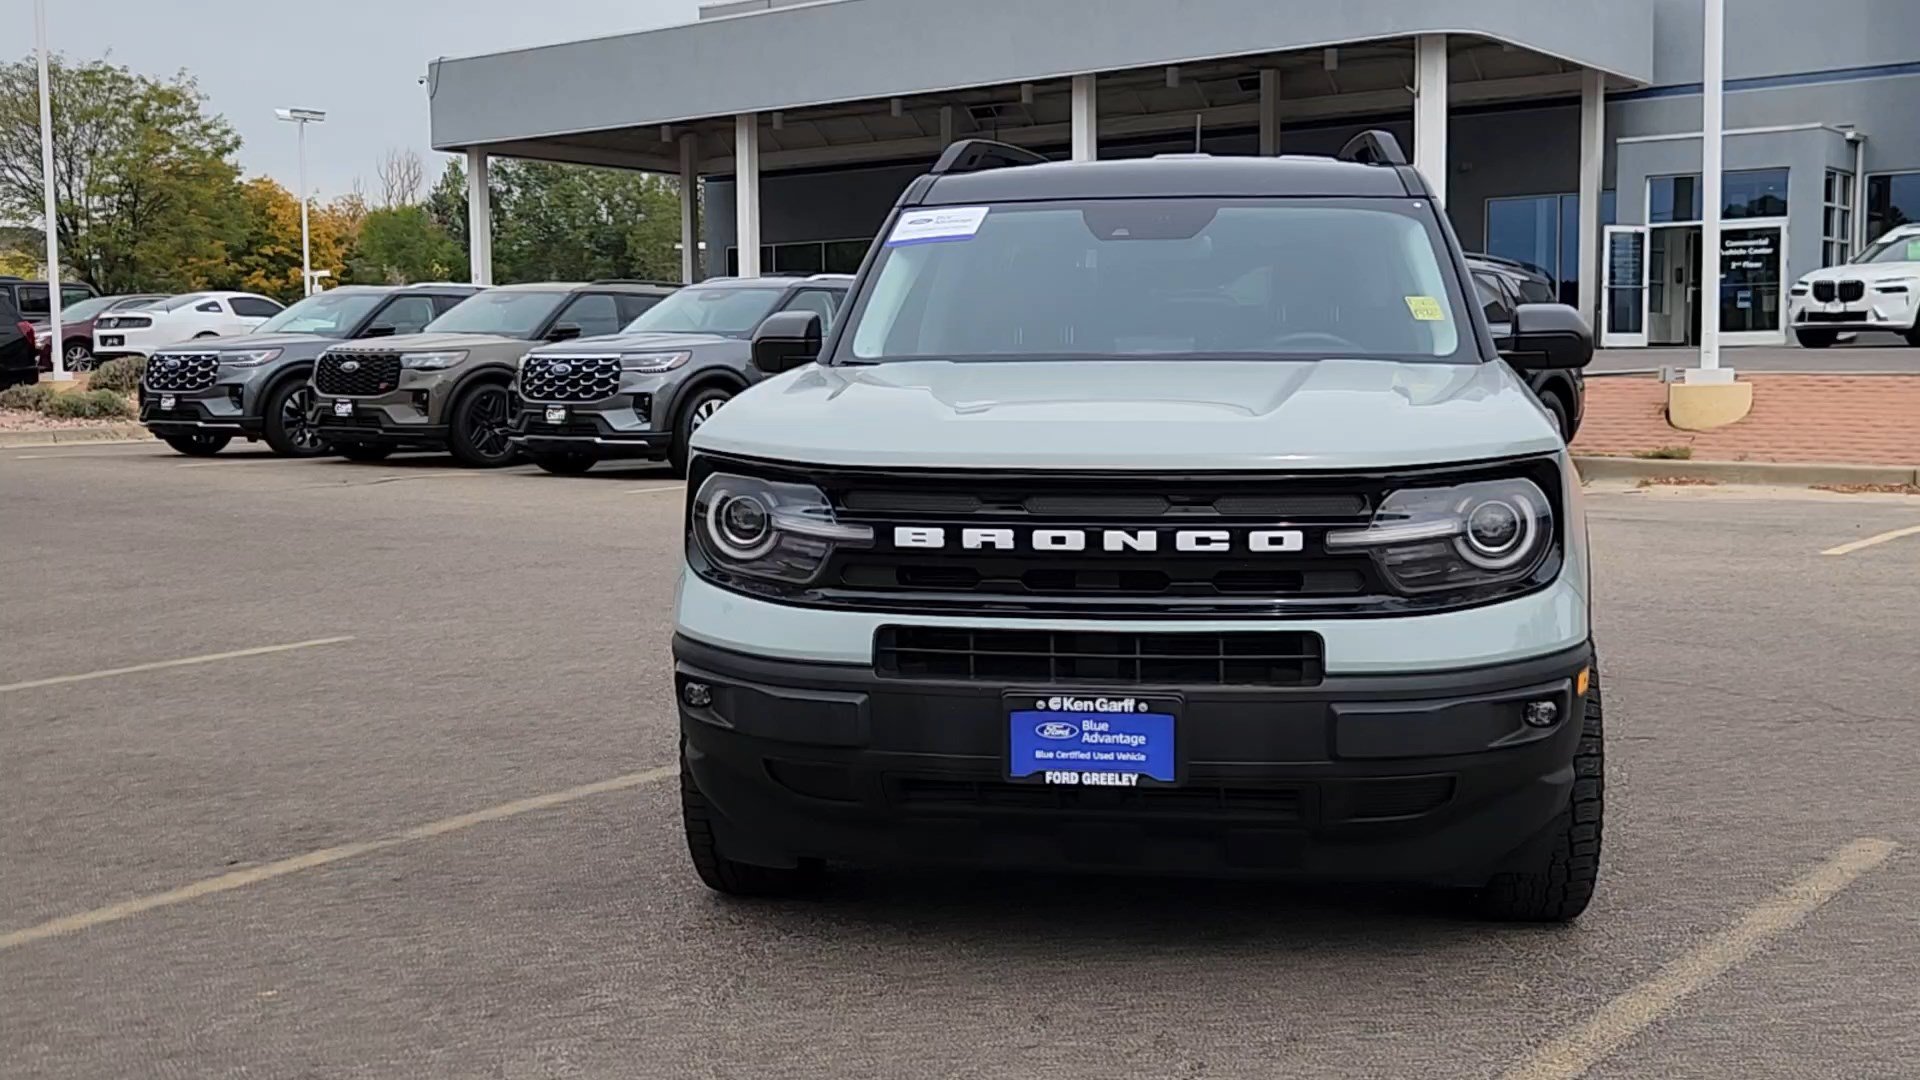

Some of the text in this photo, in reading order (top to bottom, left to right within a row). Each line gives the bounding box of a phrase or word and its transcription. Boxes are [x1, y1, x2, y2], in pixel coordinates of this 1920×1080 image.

[1725, 238, 1769, 247] Commercial
[1748, 247, 1773, 255] Center
[894, 526, 1303, 552] BRONCO
[1063, 697, 1136, 713] Ken Garff
[1082, 720, 1109, 731] Blue
[1081, 733, 1146, 747] Advantage
[1035, 750, 1146, 761] Blue Certified Used Vehicle
[1045, 771, 1139, 786] FORD GREELEY
